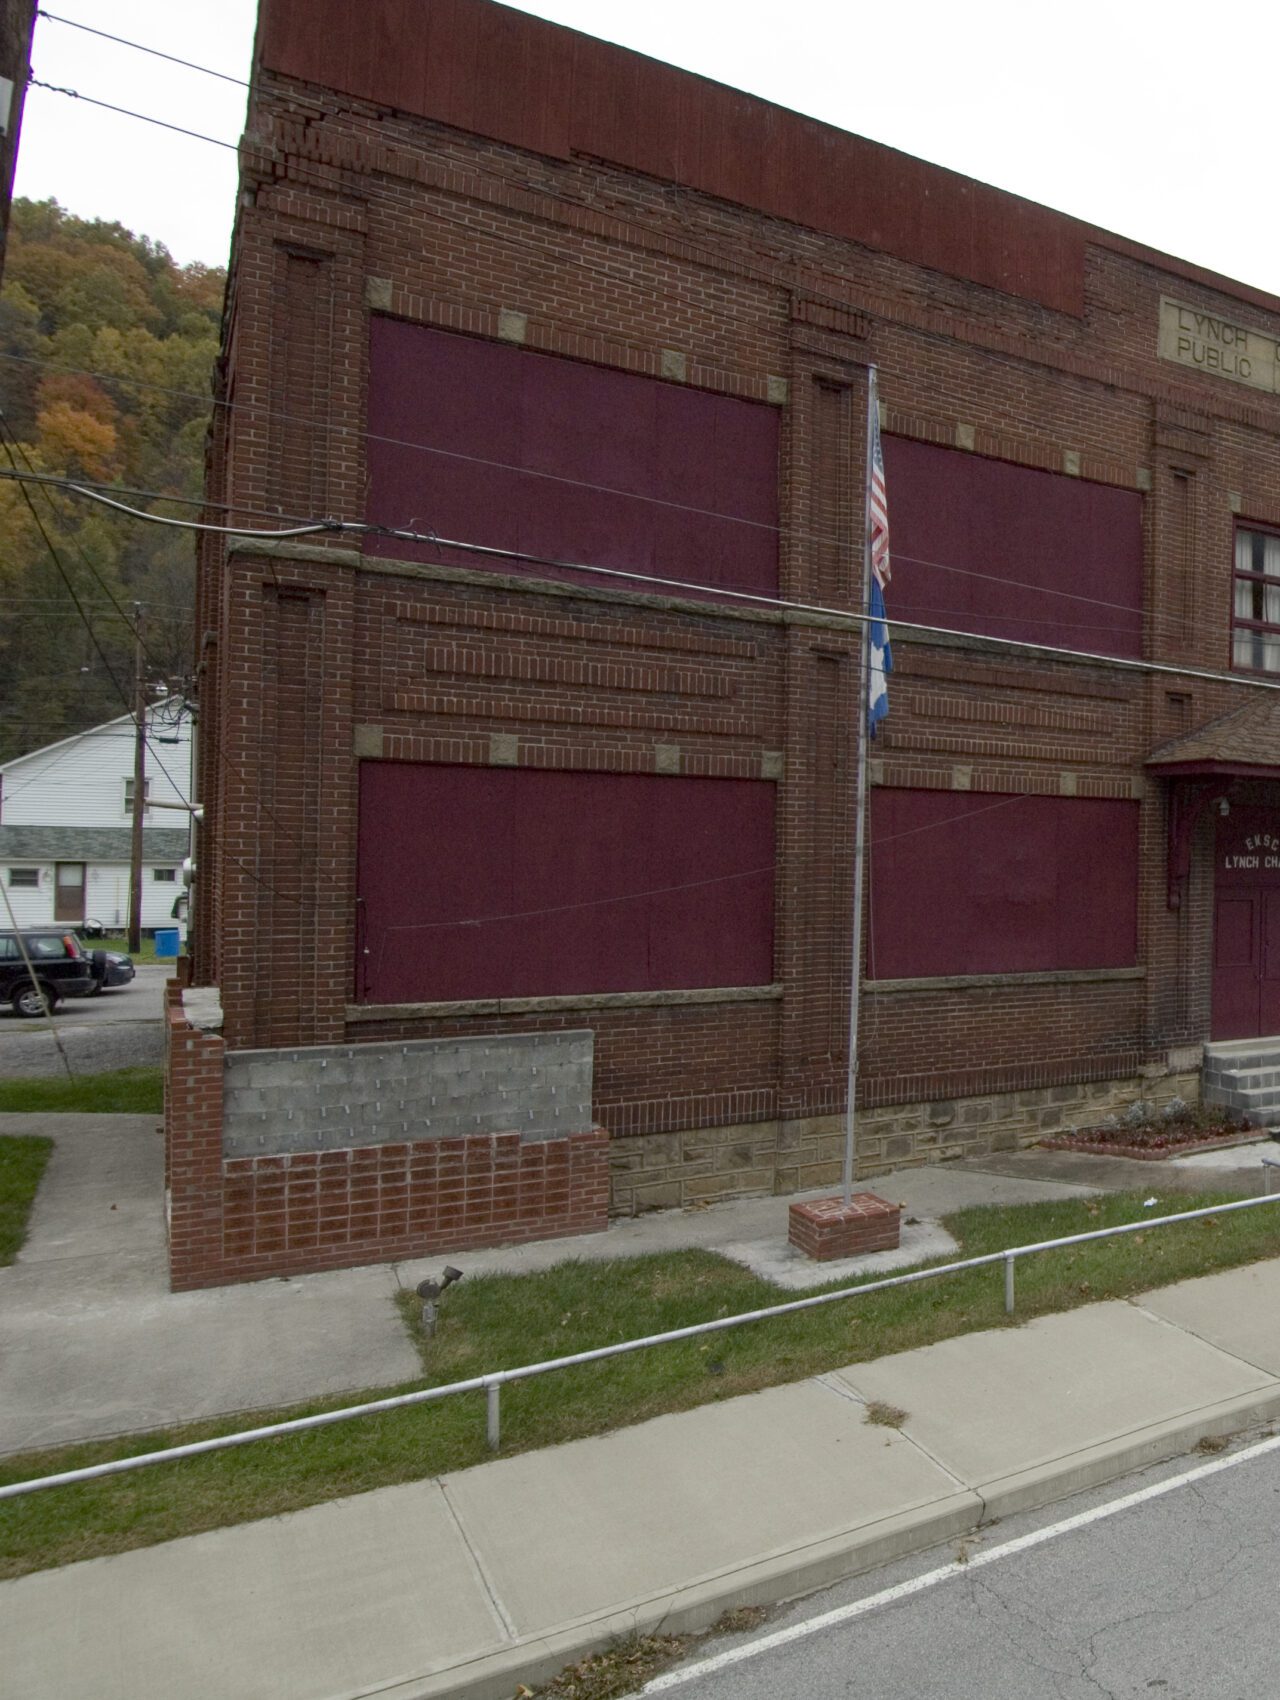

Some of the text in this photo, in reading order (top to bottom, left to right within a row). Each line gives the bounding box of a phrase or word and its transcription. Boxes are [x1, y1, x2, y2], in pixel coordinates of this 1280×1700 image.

[1178, 308, 1248, 350] LYNCH
[1177, 337, 1251, 379] PUBLIC
[1245, 834, 1279, 851] EKSC
[1225, 856, 1259, 868] LYNCH
